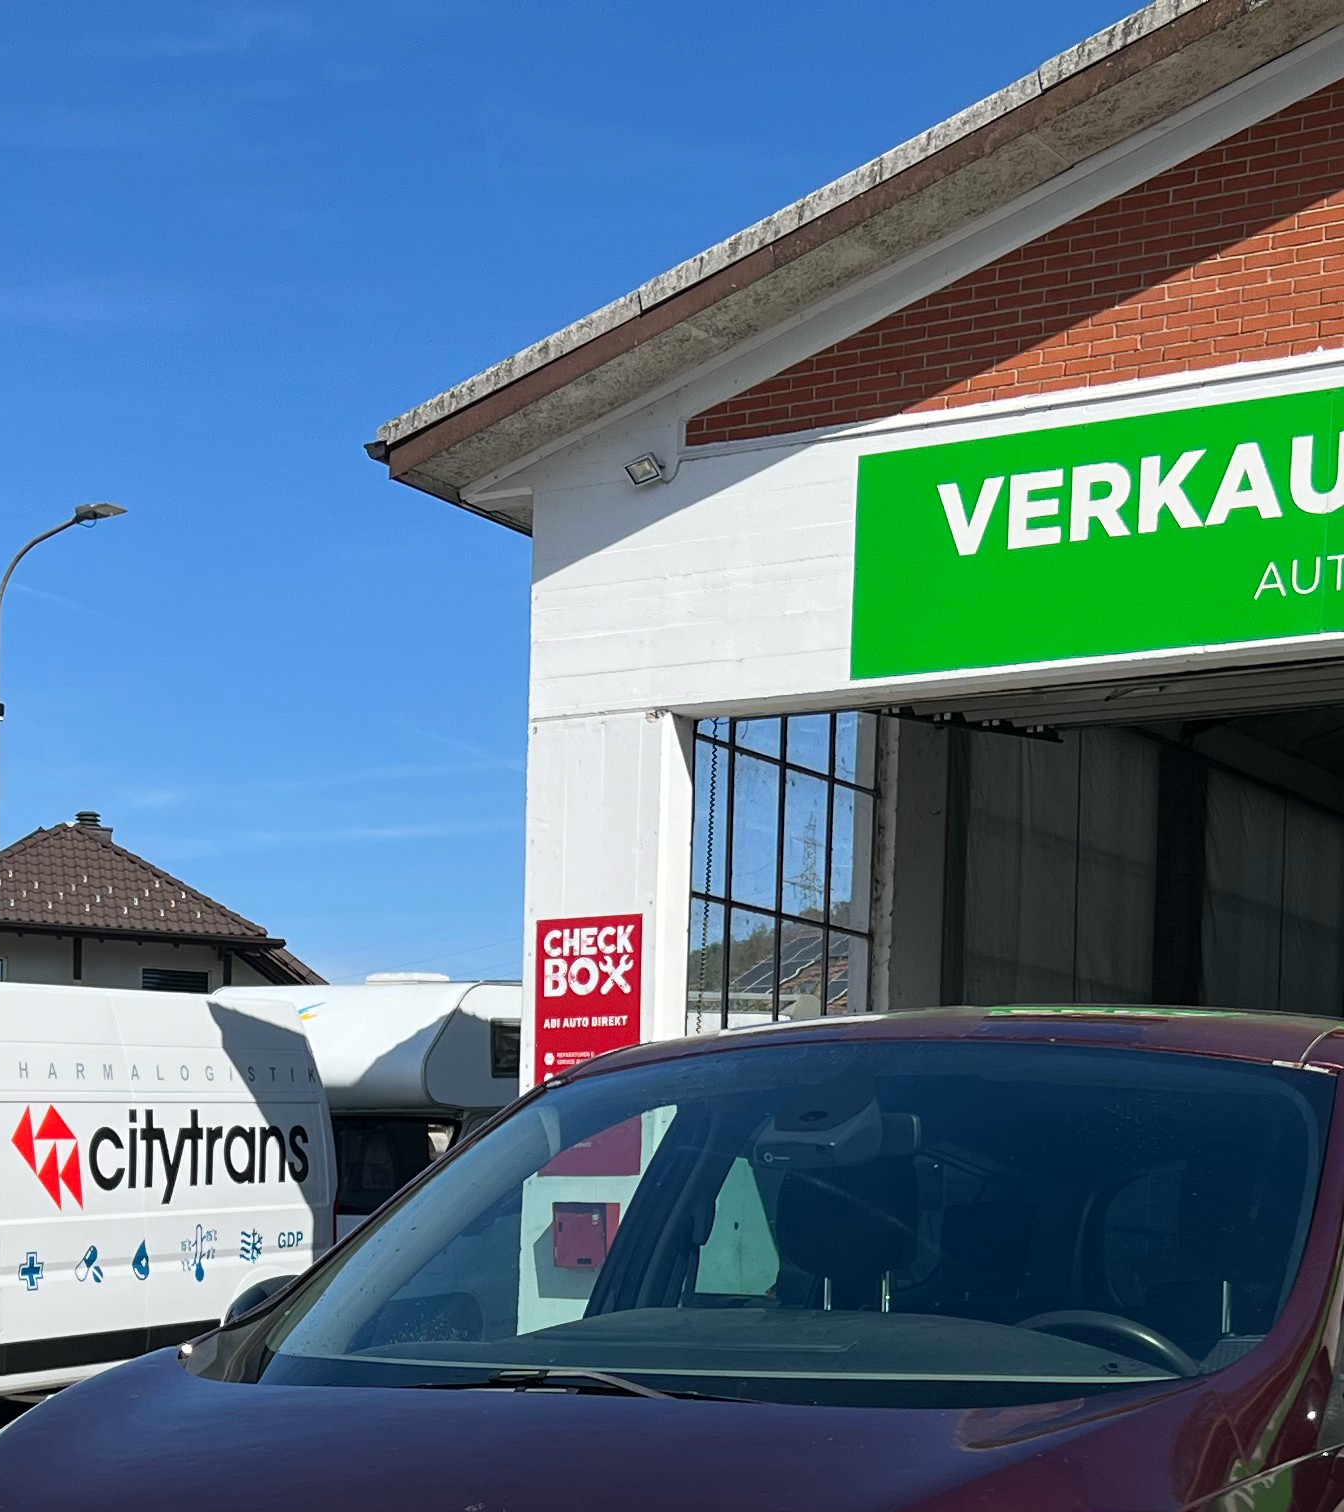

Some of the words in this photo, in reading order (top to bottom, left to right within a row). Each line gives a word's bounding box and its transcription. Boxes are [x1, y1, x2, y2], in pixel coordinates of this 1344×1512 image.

[543, 925, 636, 957] CHECK
[543, 954, 635, 998] BOX
[543, 1018, 560, 1030] ADI
[562, 1016, 588, 1028] AUTO
[591, 1015, 629, 1027] DIREKT
[88, 1108, 310, 1205] citytrans
[277, 1231, 304, 1249] GDP
